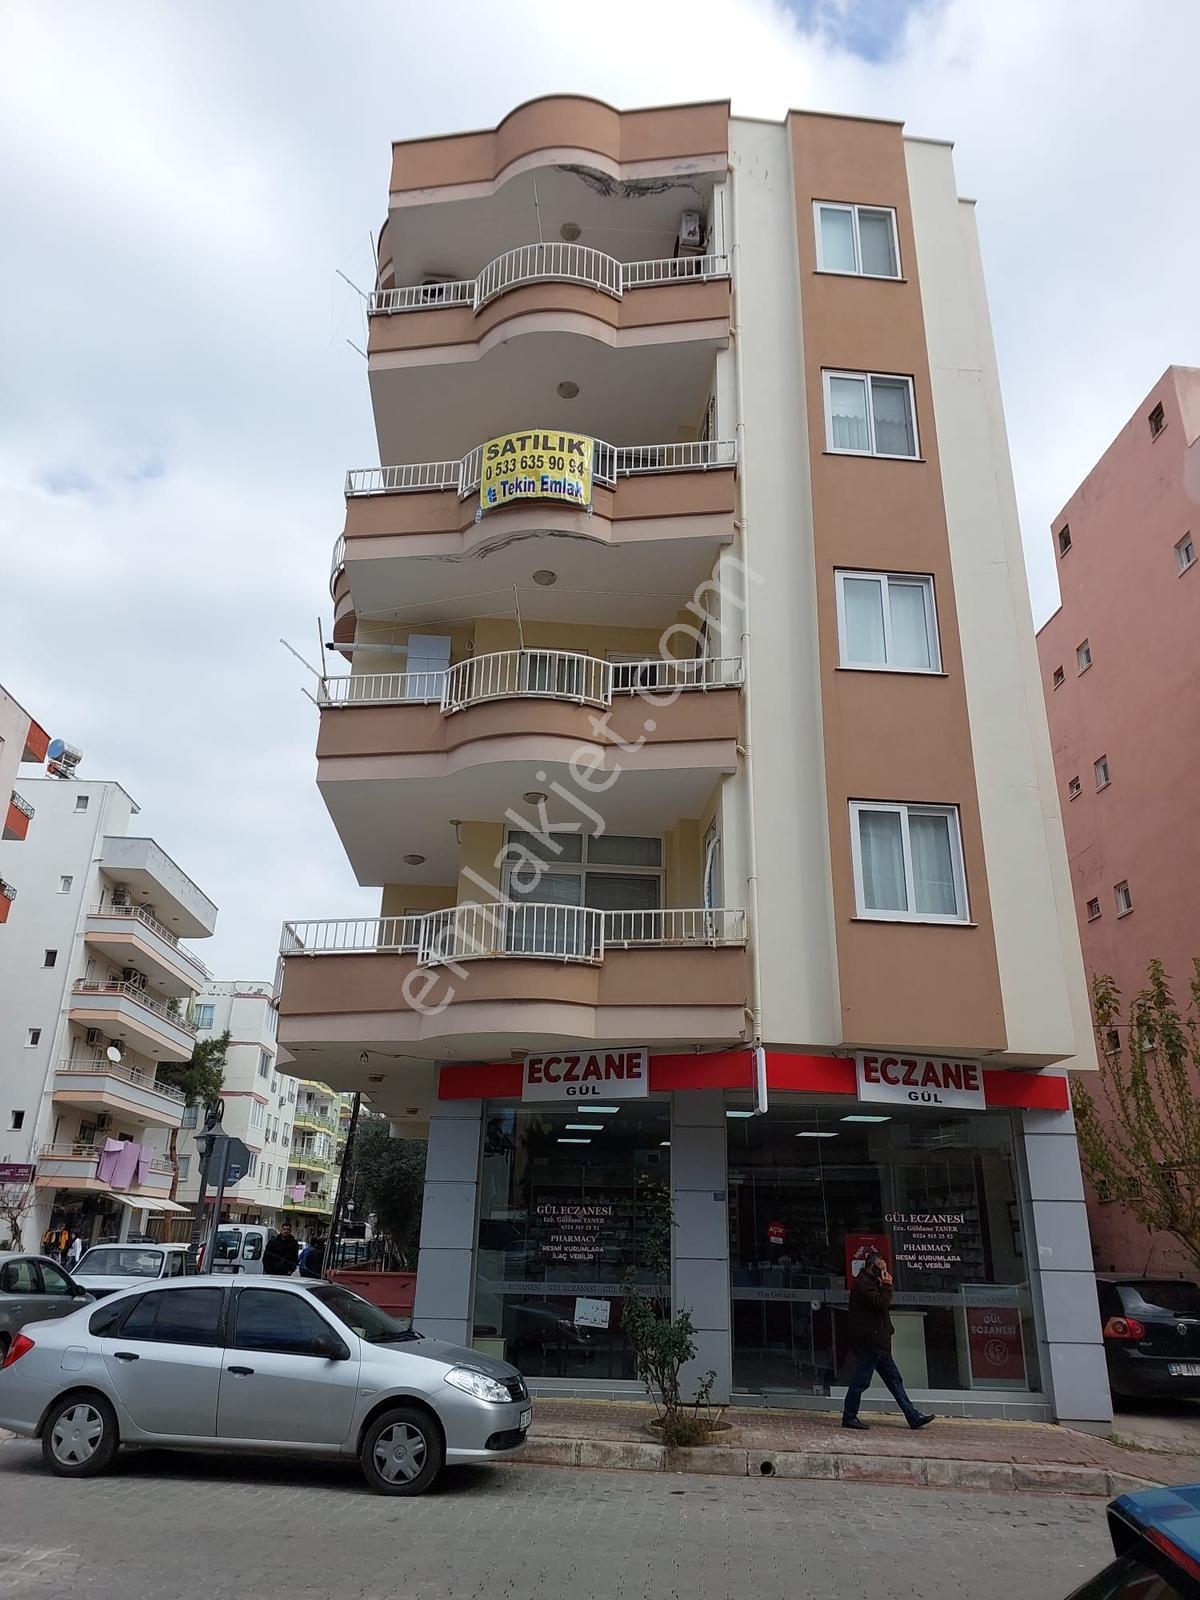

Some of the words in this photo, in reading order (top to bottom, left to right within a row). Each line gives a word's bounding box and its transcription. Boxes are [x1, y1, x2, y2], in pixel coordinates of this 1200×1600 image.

[487, 434, 586, 461] SATILIK
[486, 466, 492, 480] 0
[496, 458, 516, 477] 533
[520, 455, 544, 469] 635
[549, 455, 565, 470] 90
[569, 459, 585, 477] 94
[500, 477, 535, 497] Tekin
[540, 474, 583, 498] Emlak
[528, 1053, 642, 1084] ECZANE
[863, 1056, 980, 1091] ECZANE
[566, 1084, 601, 1096] GÜL
[908, 1089, 943, 1103] GÜL
[537, 1204, 558, 1214] GÜL
[561, 1206, 612, 1215] ECZANESİ
[884, 1212, 908, 1222] GÜL
[910, 1213, 965, 1223] ECZANESİ
[552, 1252, 567, 1260] İLAÇ
[907, 1262, 923, 1270] İLAÇ
